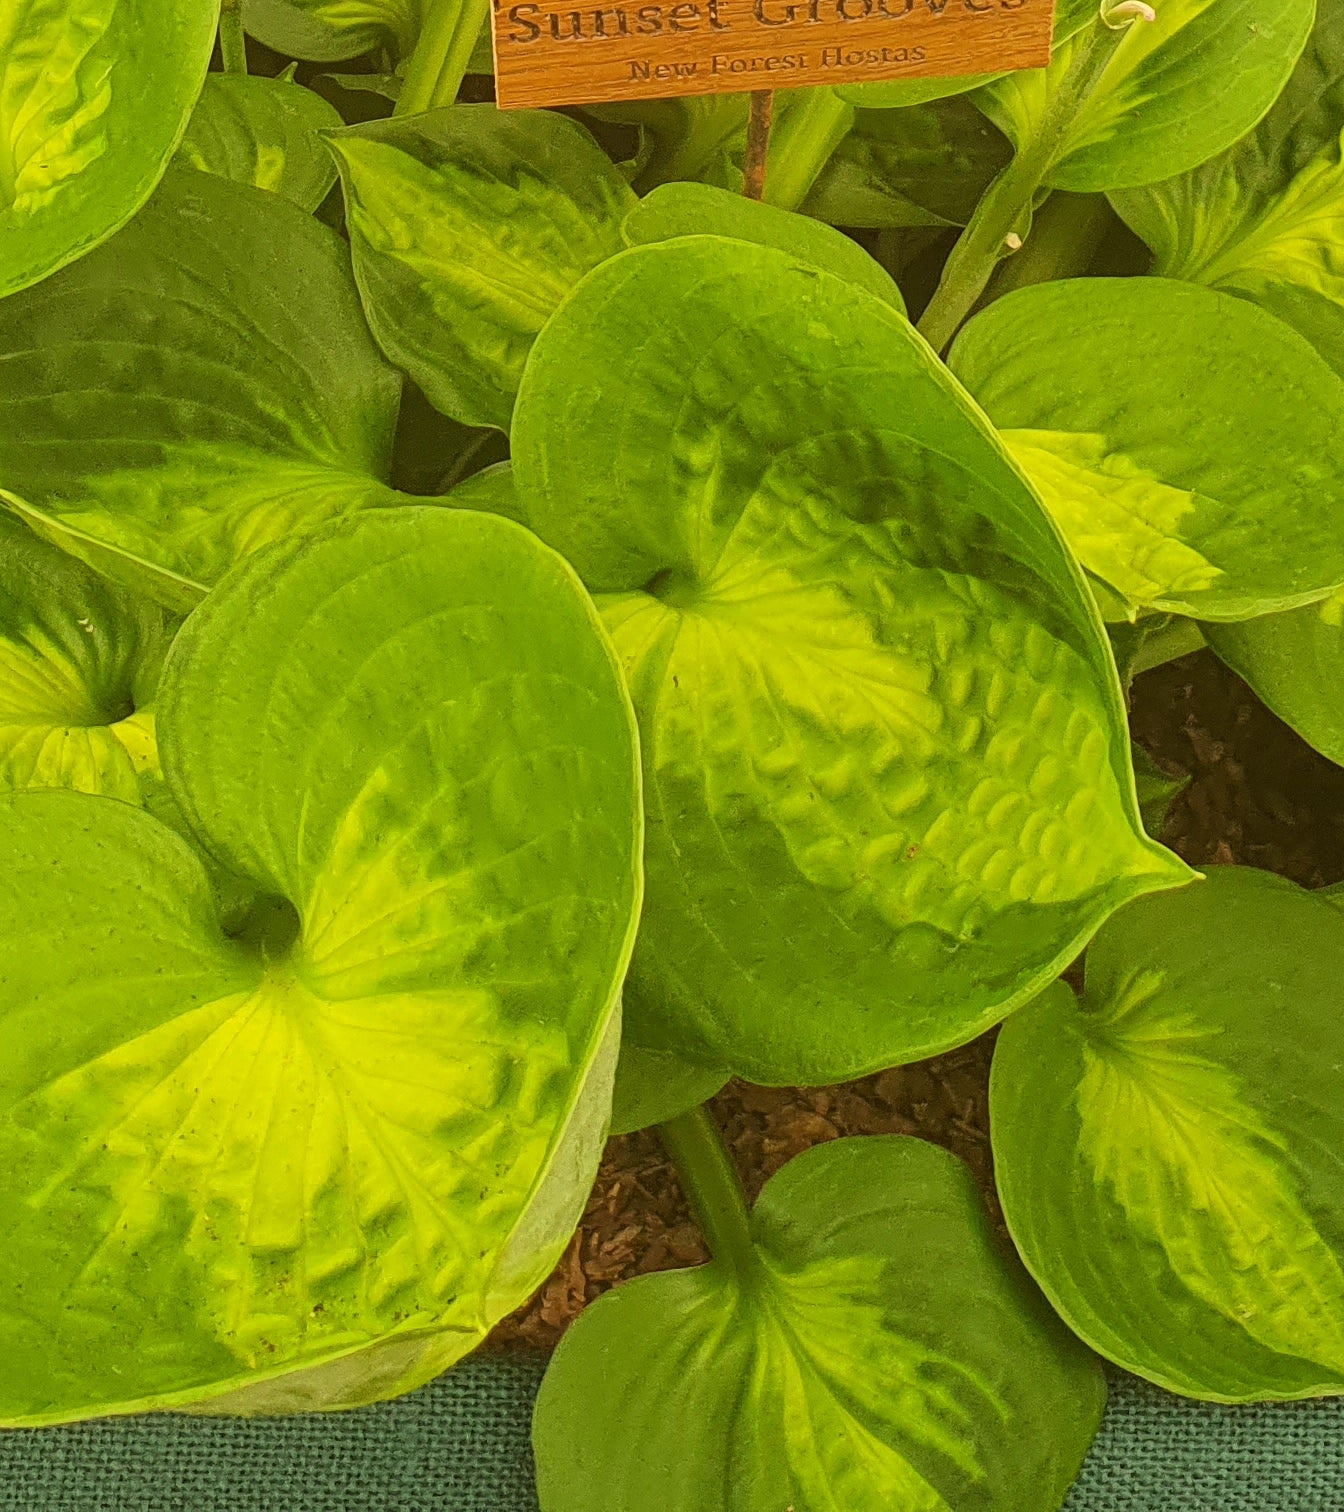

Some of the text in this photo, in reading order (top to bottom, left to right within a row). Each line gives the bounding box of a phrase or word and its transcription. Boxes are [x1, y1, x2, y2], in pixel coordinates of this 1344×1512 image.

[628, 43, 927, 81] New Forest Hostas
